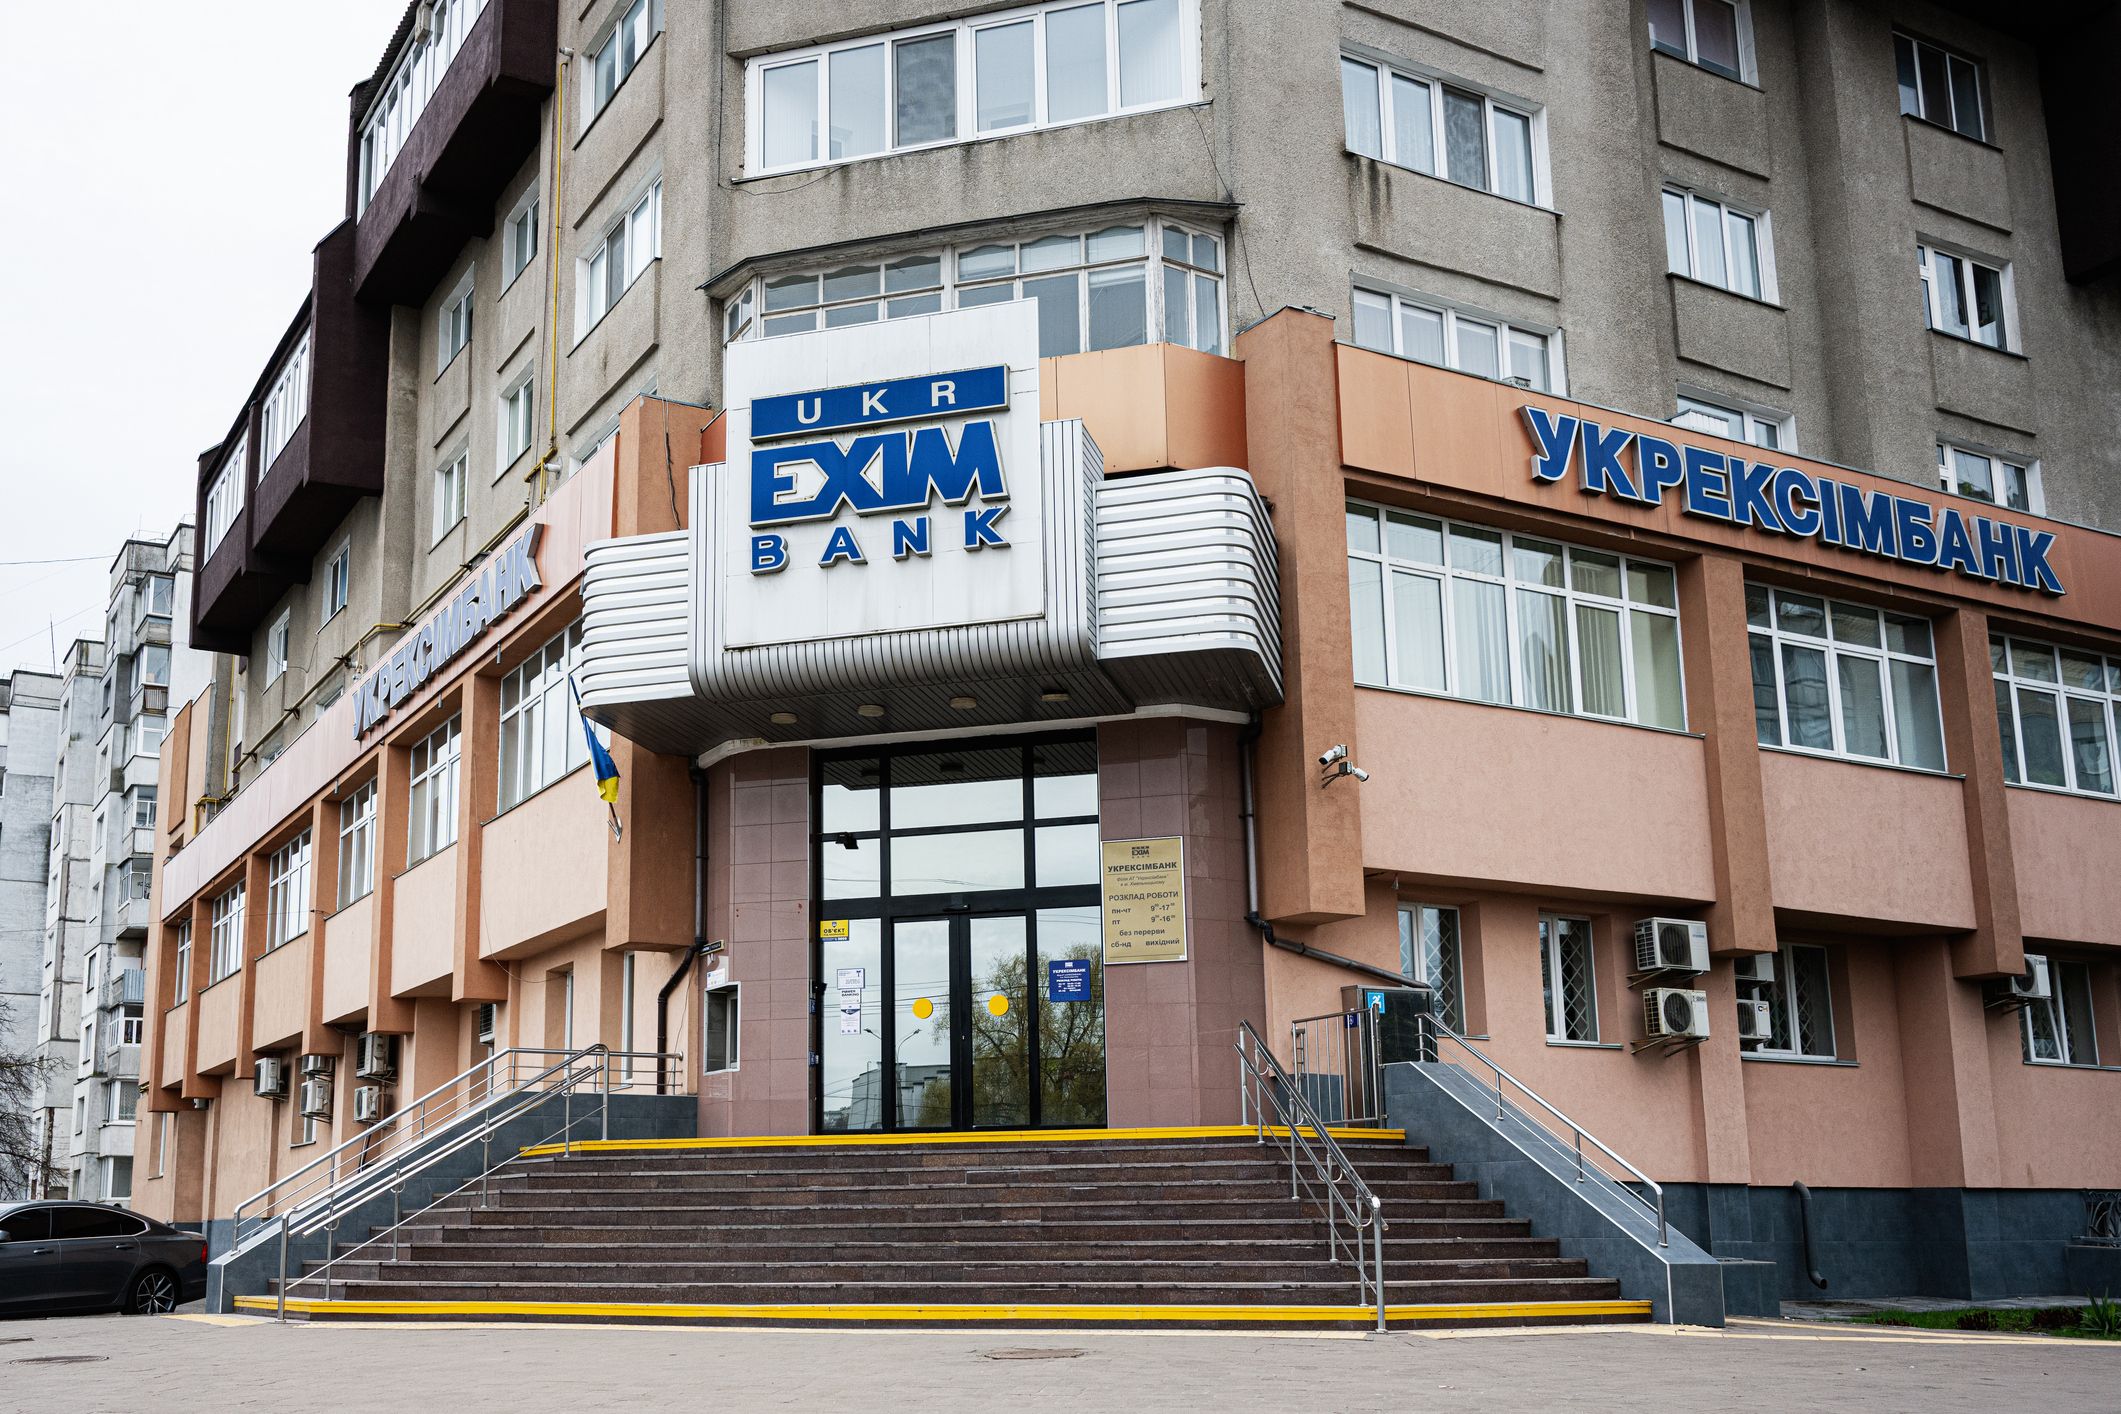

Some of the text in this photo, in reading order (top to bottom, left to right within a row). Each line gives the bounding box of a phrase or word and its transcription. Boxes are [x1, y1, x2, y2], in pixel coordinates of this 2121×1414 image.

[797, 380, 956, 424] UKR
[750, 418, 1011, 529] EXIM
[1519, 405, 2066, 595] УКРЕКСІМБАНК
[750, 504, 1011, 575] BANK
[352, 523, 544, 740] УКРЕКСІМБАНК
[1107, 861, 1177, 873] УКРЕКСІМБАНК
[1108, 891, 1179, 901] РОЗКЛАД РОБОТИ
[1119, 928, 1165, 937] без перерви
